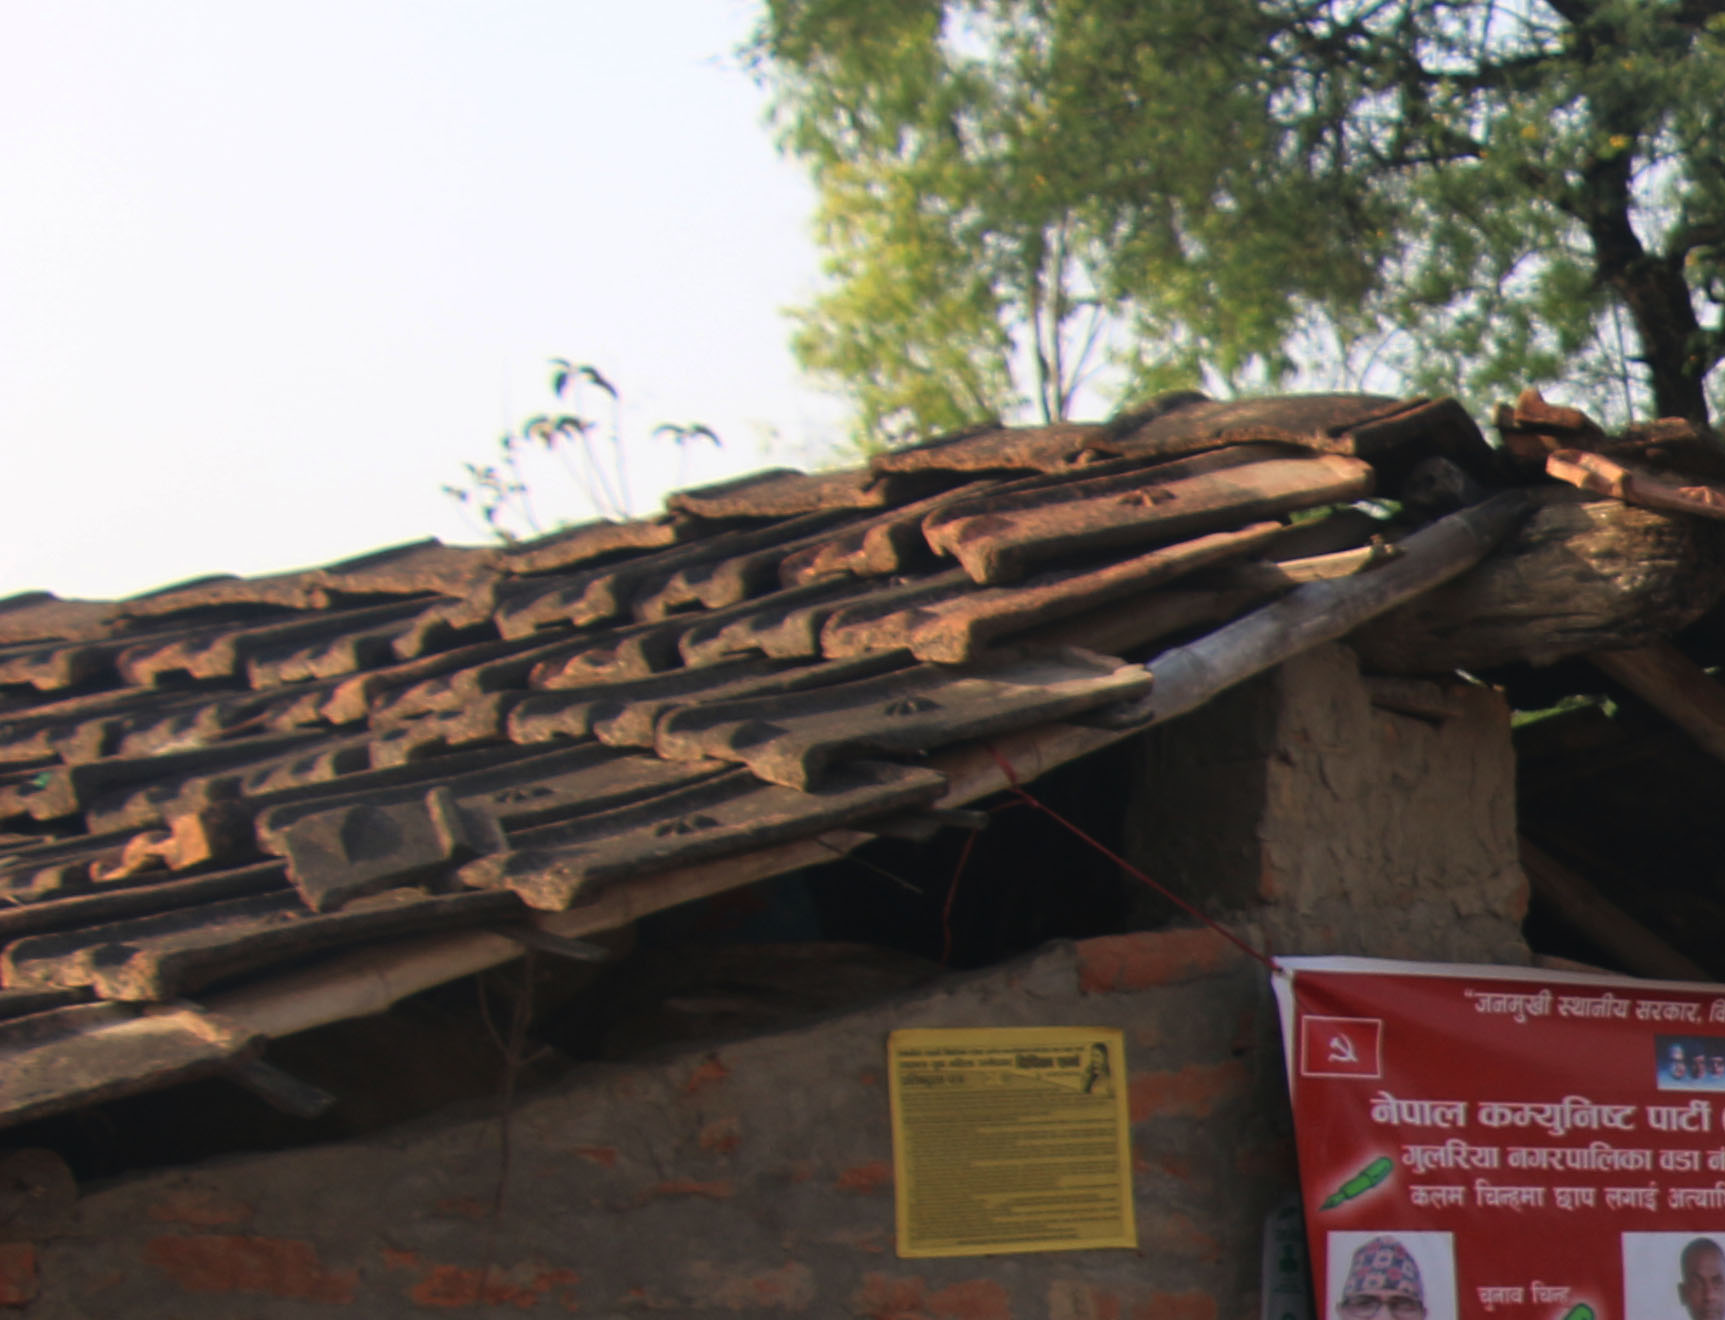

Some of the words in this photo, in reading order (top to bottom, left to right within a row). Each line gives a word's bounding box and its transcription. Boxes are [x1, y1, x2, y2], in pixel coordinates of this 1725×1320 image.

[1558, 993, 1628, 1017] स्थानीय
[1370, 1091, 1468, 1127] नेपाल
[1478, 1096, 1636, 1136] कम्युनिष्ट
[1646, 1100, 1711, 1133] पार्टी
[1402, 1138, 1500, 1174] गुलरिया
[1507, 1141, 1652, 1170] नगरपालिका
[1660, 1148, 1700, 1172] वडा
[1409, 1185, 1464, 1208] कलम
[1474, 1178, 1544, 1211] चिन्हमा
[1554, 1187, 1595, 1210] छाप
[1605, 1180, 1658, 1211] लगाई
[1477, 1285, 1524, 1311] चुनाव
